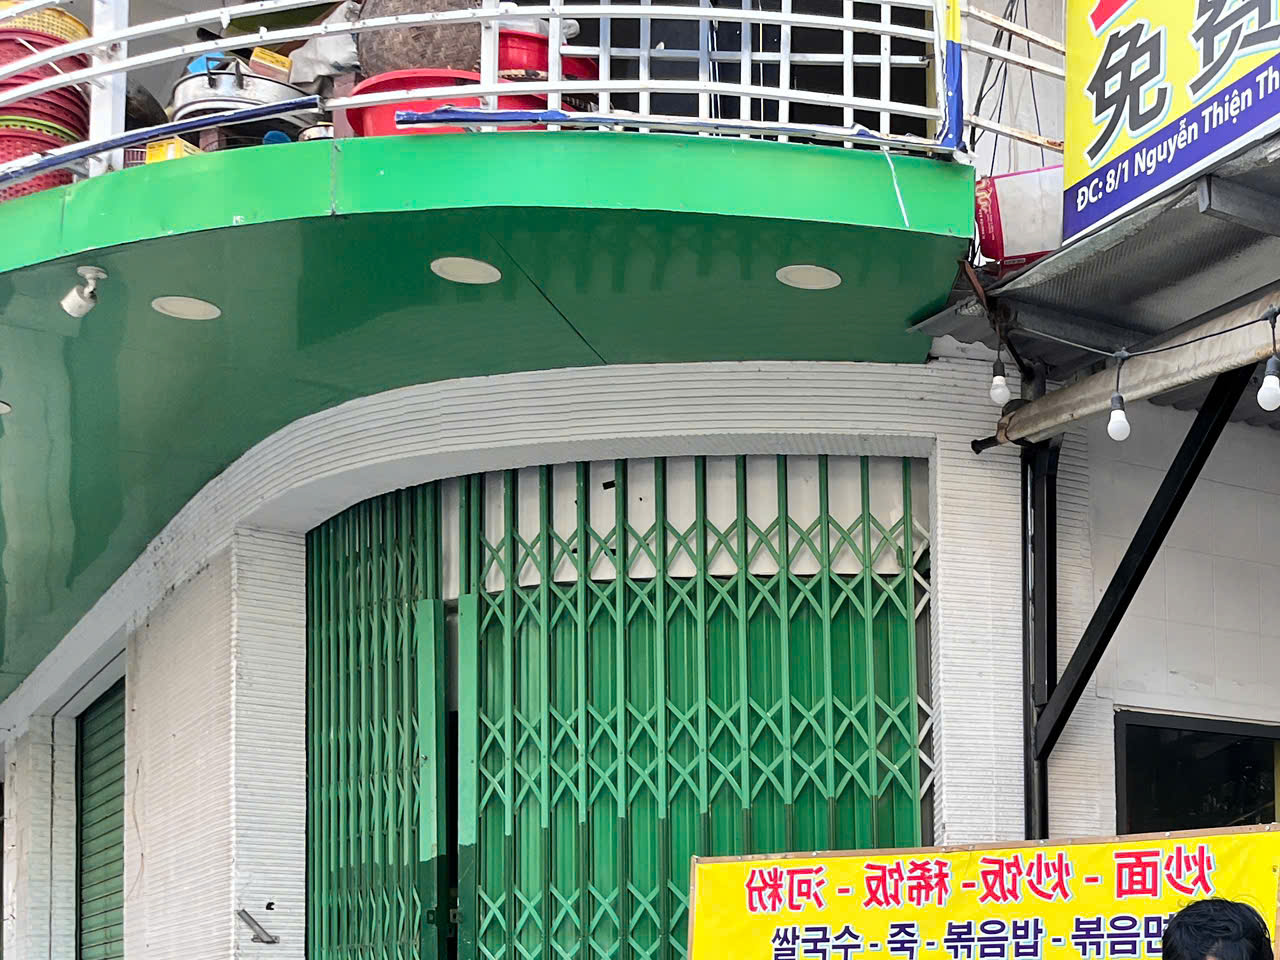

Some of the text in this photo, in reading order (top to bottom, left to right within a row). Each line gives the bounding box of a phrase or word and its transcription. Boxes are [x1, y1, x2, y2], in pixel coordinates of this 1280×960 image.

[1077, 179, 1103, 212] ĐC:
[1106, 158, 1129, 193] 8/1
[1134, 118, 1198, 176] Nguyễn
[1202, 88, 1252, 134] Thiện
[887, 923, 918, 960] 죽
[943, 918, 1043, 960] 볶음밥
